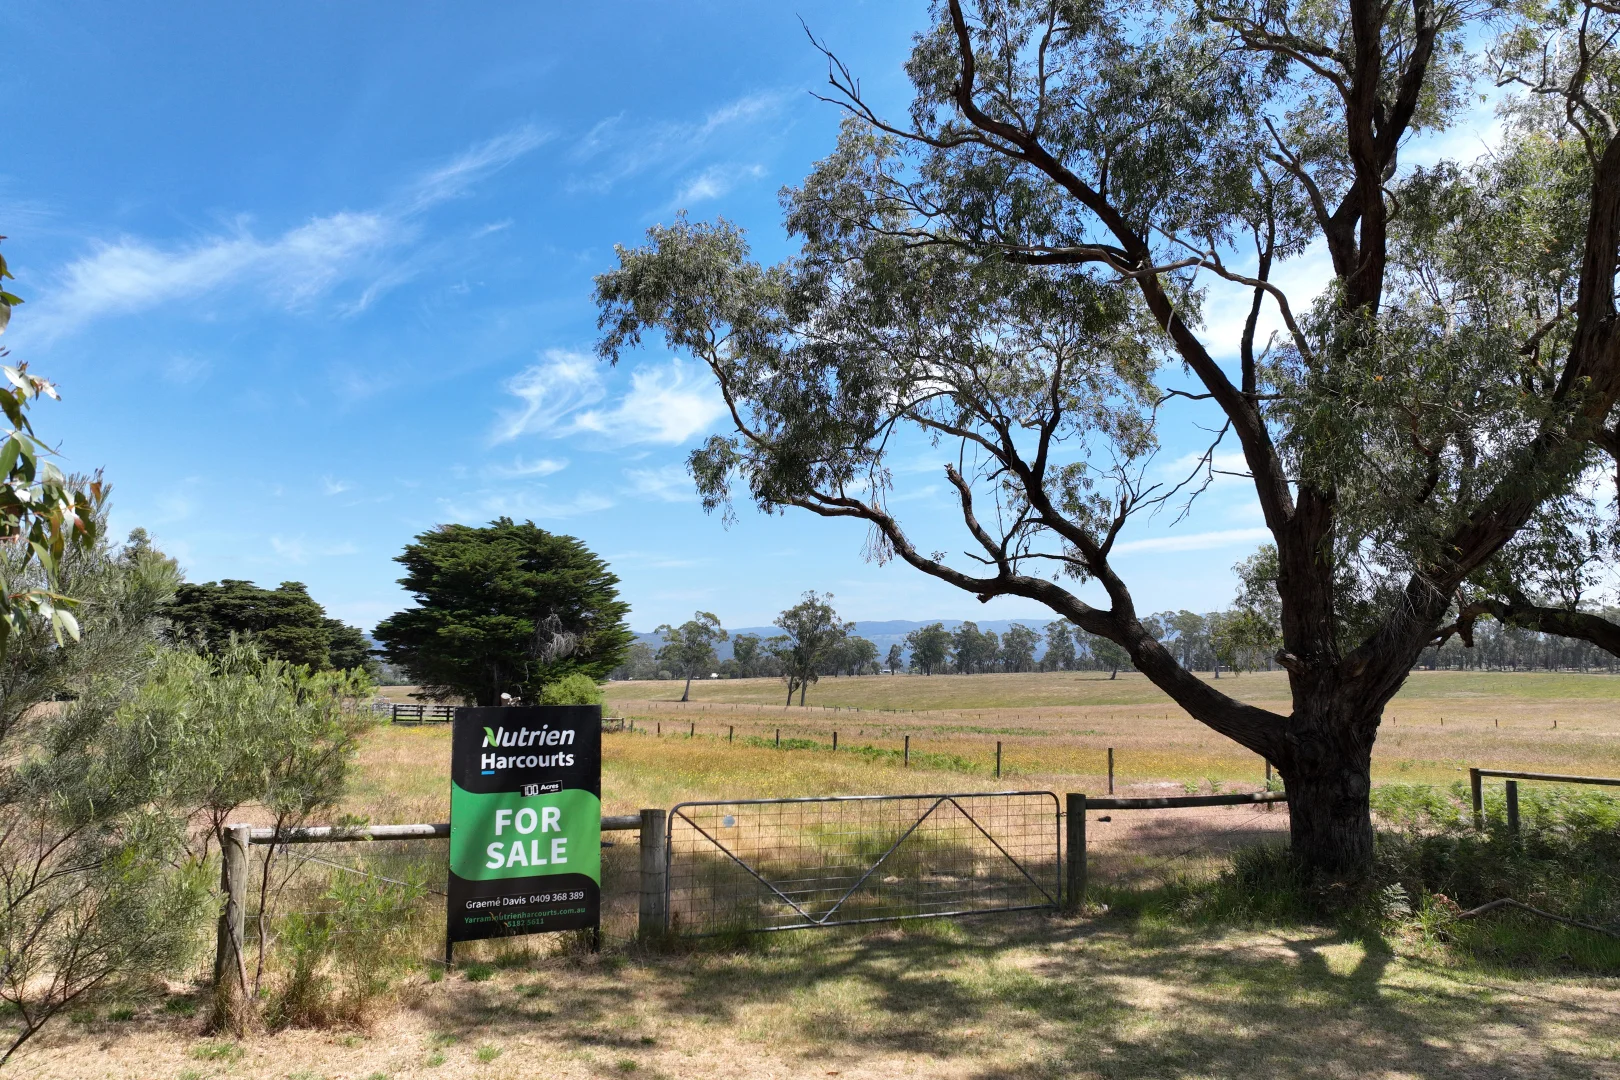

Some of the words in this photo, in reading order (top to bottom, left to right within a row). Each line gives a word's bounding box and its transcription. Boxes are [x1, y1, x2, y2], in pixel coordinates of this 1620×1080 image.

[482, 724, 575, 748] Nutrien
[481, 751, 575, 770] Harcourts
[495, 806, 561, 836] FOR
[485, 837, 568, 870] SALE
[502, 896, 527, 906] Davis
[529, 894, 551, 904] 0409
[552, 892, 568, 902] 368
[568, 891, 584, 901] 389
[526, 917, 545, 926] 5611
